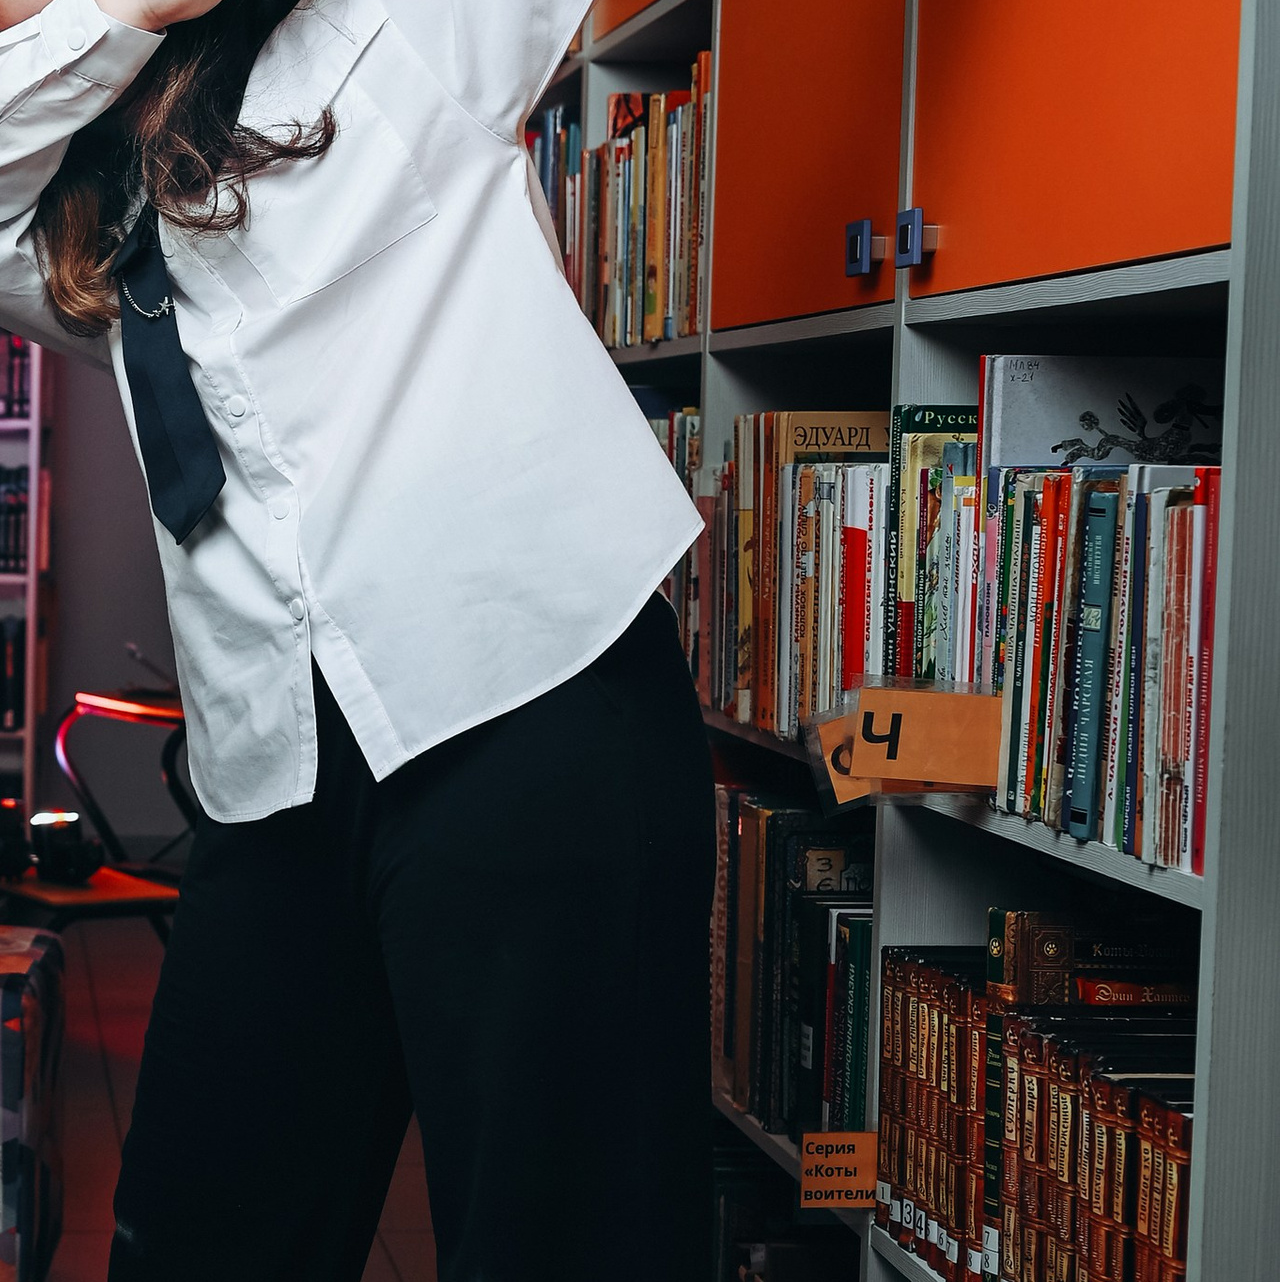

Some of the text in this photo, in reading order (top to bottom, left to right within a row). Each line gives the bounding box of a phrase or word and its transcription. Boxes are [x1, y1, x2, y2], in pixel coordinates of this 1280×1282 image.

[794, 427, 870, 449] ЭДУАРД
[924, 412, 978, 427] Русск
[801, 504, 809, 536] СЛЕДУ
[801, 540, 808, 555] ПО
[1031, 531, 1041, 593] ПИТОМЦЫ
[1122, 535, 1131, 565] ФЕИ
[888, 530, 898, 633] УШИНСКИЙ
[917, 568, 925, 620] ЖИВОТНЫХ
[1034, 517, 1048, 647] Питомцы зоопарка
[1009, 576, 1017, 630] ЧАПЛИНА
[1119, 569, 1128, 636] ГОЛУБОЙ
[1016, 639, 1024, 676] ЧАПЛИНА
[1115, 639, 1123, 697] СКАЗКИ
[1187, 654, 1195, 685] ДЕТЕЙ
[862, 711, 902, 760] Ч
[1077, 658, 1094, 784] ЛИДИЯ ЧАРСКАЯ
[1185, 709, 1193, 761] РАССКАЗЫ
[1196, 645, 1210, 804] ДНЕВНИК ФОКСА МИККИ
[1109, 716, 1118, 782] ЧАРСКАЯ
[1182, 784, 1190, 825] ЧЁРНЫЙ
[845, 963, 856, 1088] СКАЗКИ НАРОДНЫЕ
[918, 1032, 926, 1076] Бушующая
[1050, 1086, 1059, 1113] река
[806, 1142, 855, 1158] Серия
[1022, 1121, 1034, 1159] Знак
[1058, 1095, 1069, 1178] Отверженные
[805, 1165, 857, 1178] «Коты
[1094, 1125, 1105, 1211] Восход солнца
[804, 1188, 876, 1201] воители
[881, 1186, 885, 1200] 1
[904, 1203, 912, 1224] 3
[916, 1212, 924, 1235] 4
[1003, 1207, 1012, 1241] Хантер
[939, 1232, 944, 1246] 6
[984, 1231, 990, 1245] 7
[1024, 1230, 1034, 1265] Хантер
[984, 1253, 990, 1268] 8
